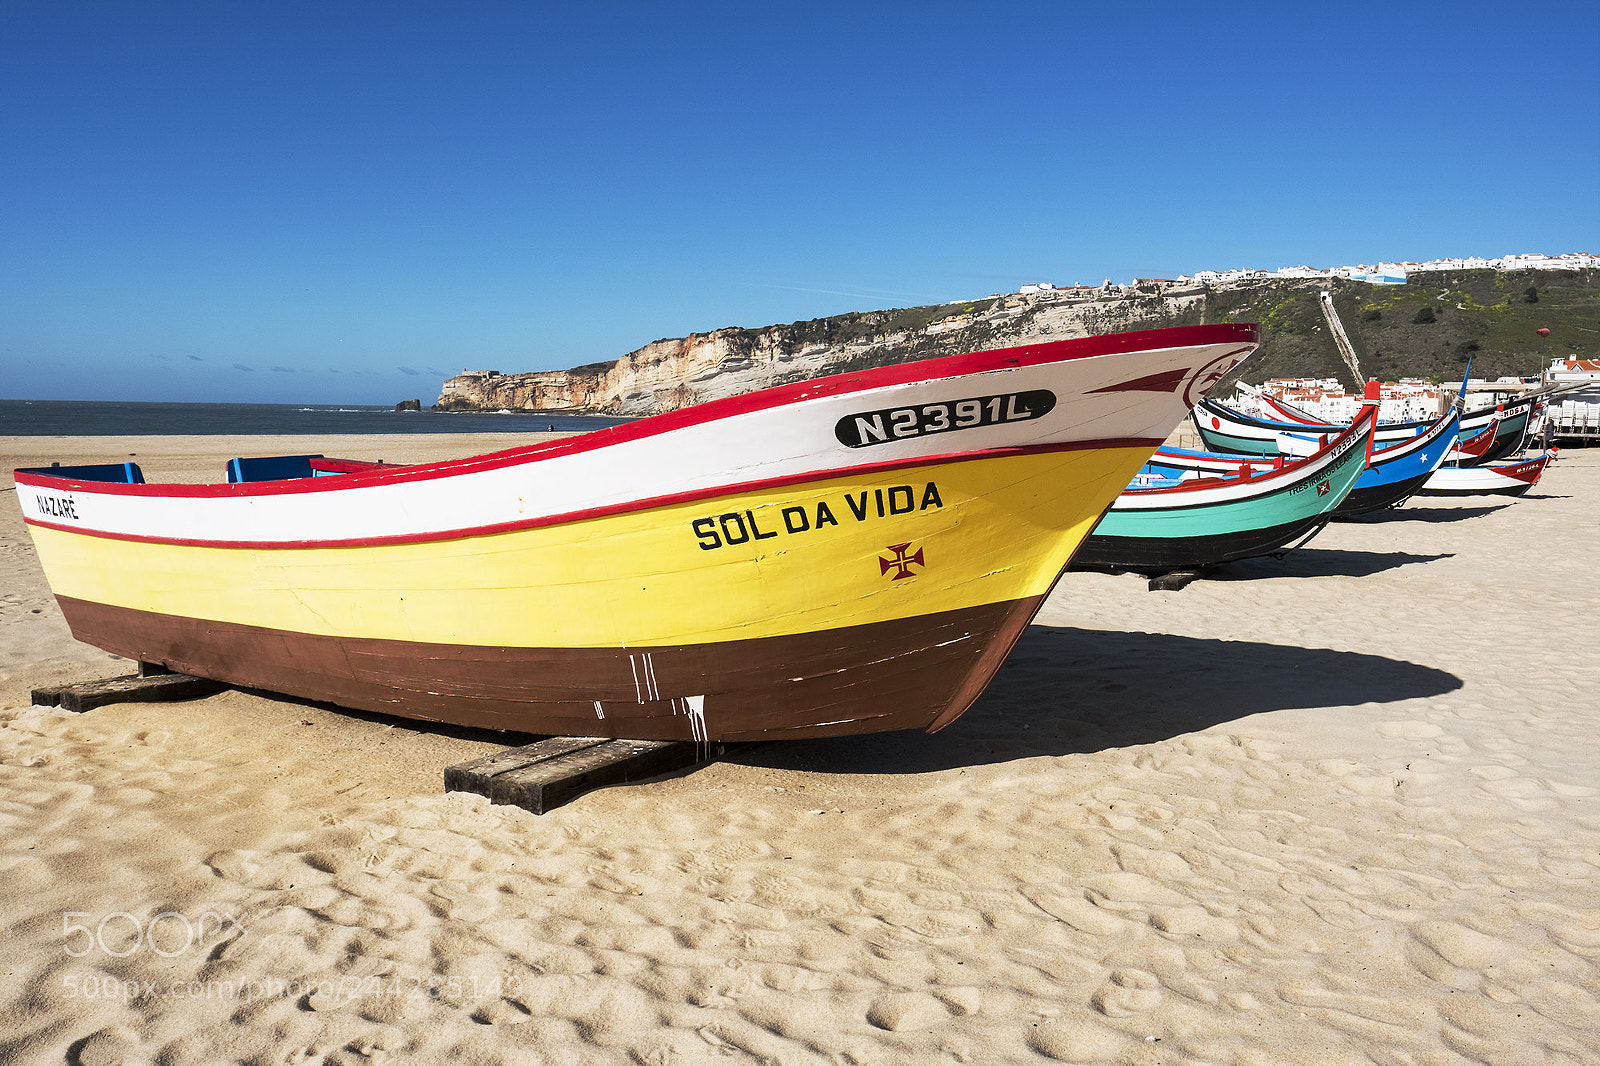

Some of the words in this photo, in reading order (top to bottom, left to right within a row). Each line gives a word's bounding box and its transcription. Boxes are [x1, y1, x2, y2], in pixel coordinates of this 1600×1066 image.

[854, 395, 1033, 445] N2391L
[1330, 429, 1362, 459] N2393L
[1288, 480, 1309, 496] TRES
[36, 494, 79, 519] NAZARÉ
[692, 509, 778, 551] SOL
[782, 501, 839, 534] DA
[844, 481, 944, 522] VIDA
